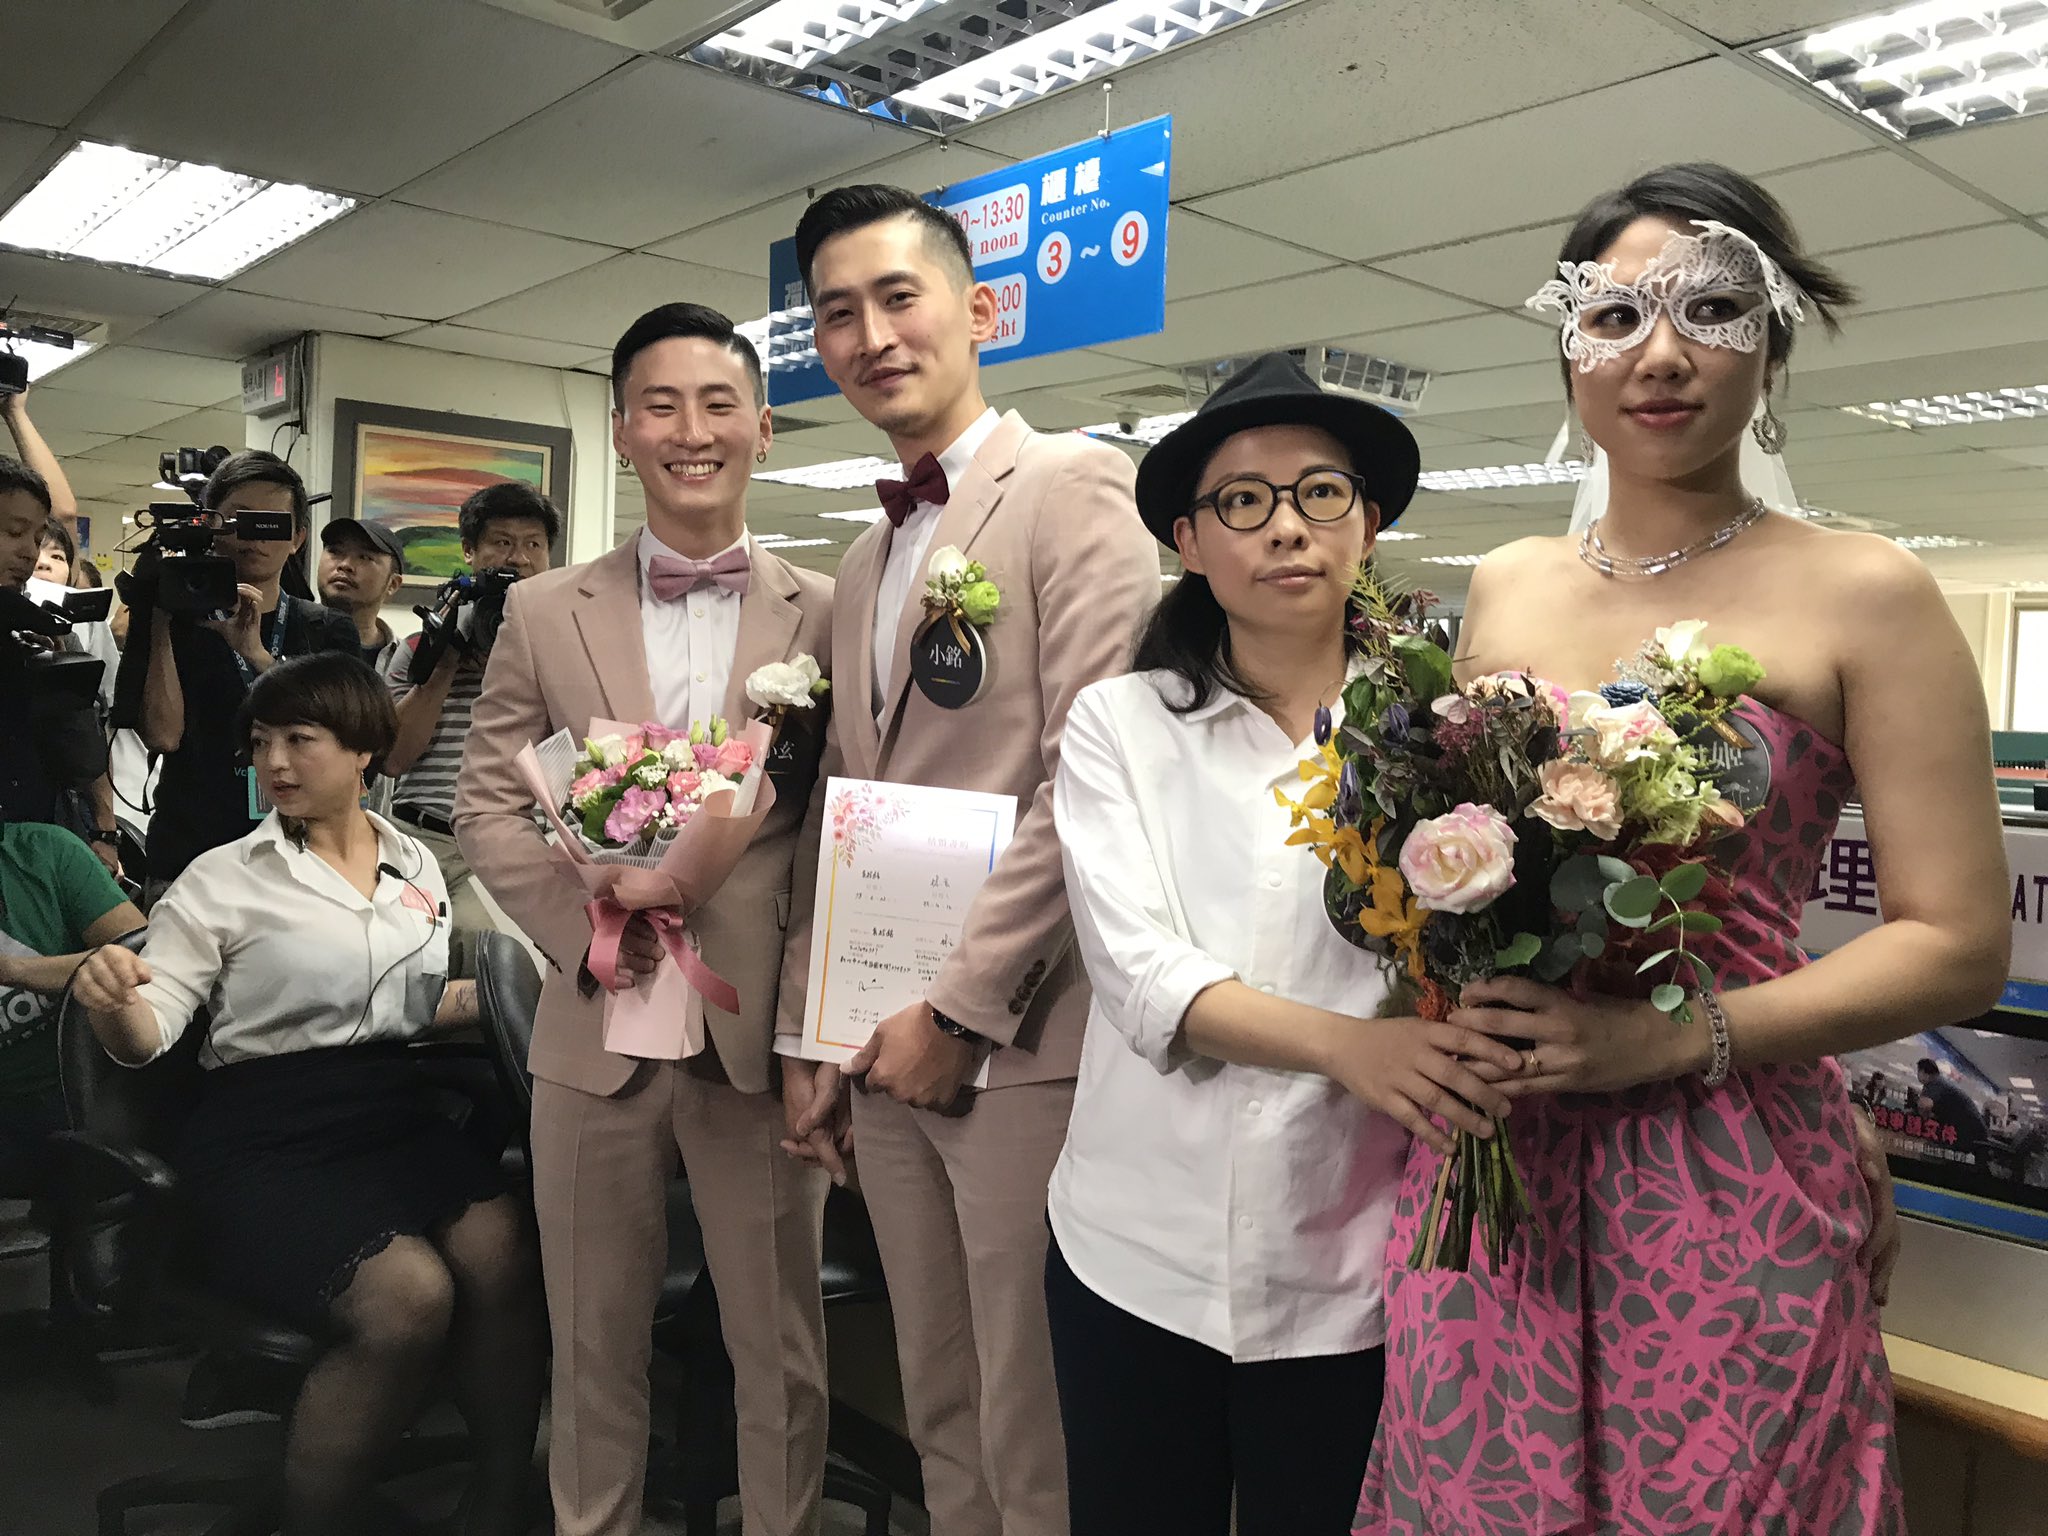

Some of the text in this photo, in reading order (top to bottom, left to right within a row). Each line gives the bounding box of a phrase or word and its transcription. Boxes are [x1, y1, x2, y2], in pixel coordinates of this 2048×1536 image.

[953, 193, 1024, 233] 0~13:30
[1041, 197, 1110, 225] Counter No.
[980, 232, 1018, 255] noon
[1046, 240, 1062, 277] 3
[1122, 220, 1140, 260] 9
[992, 282, 1021, 312] :00
[991, 318, 1016, 343] ght
[2012, 873, 2048, 924] AT
